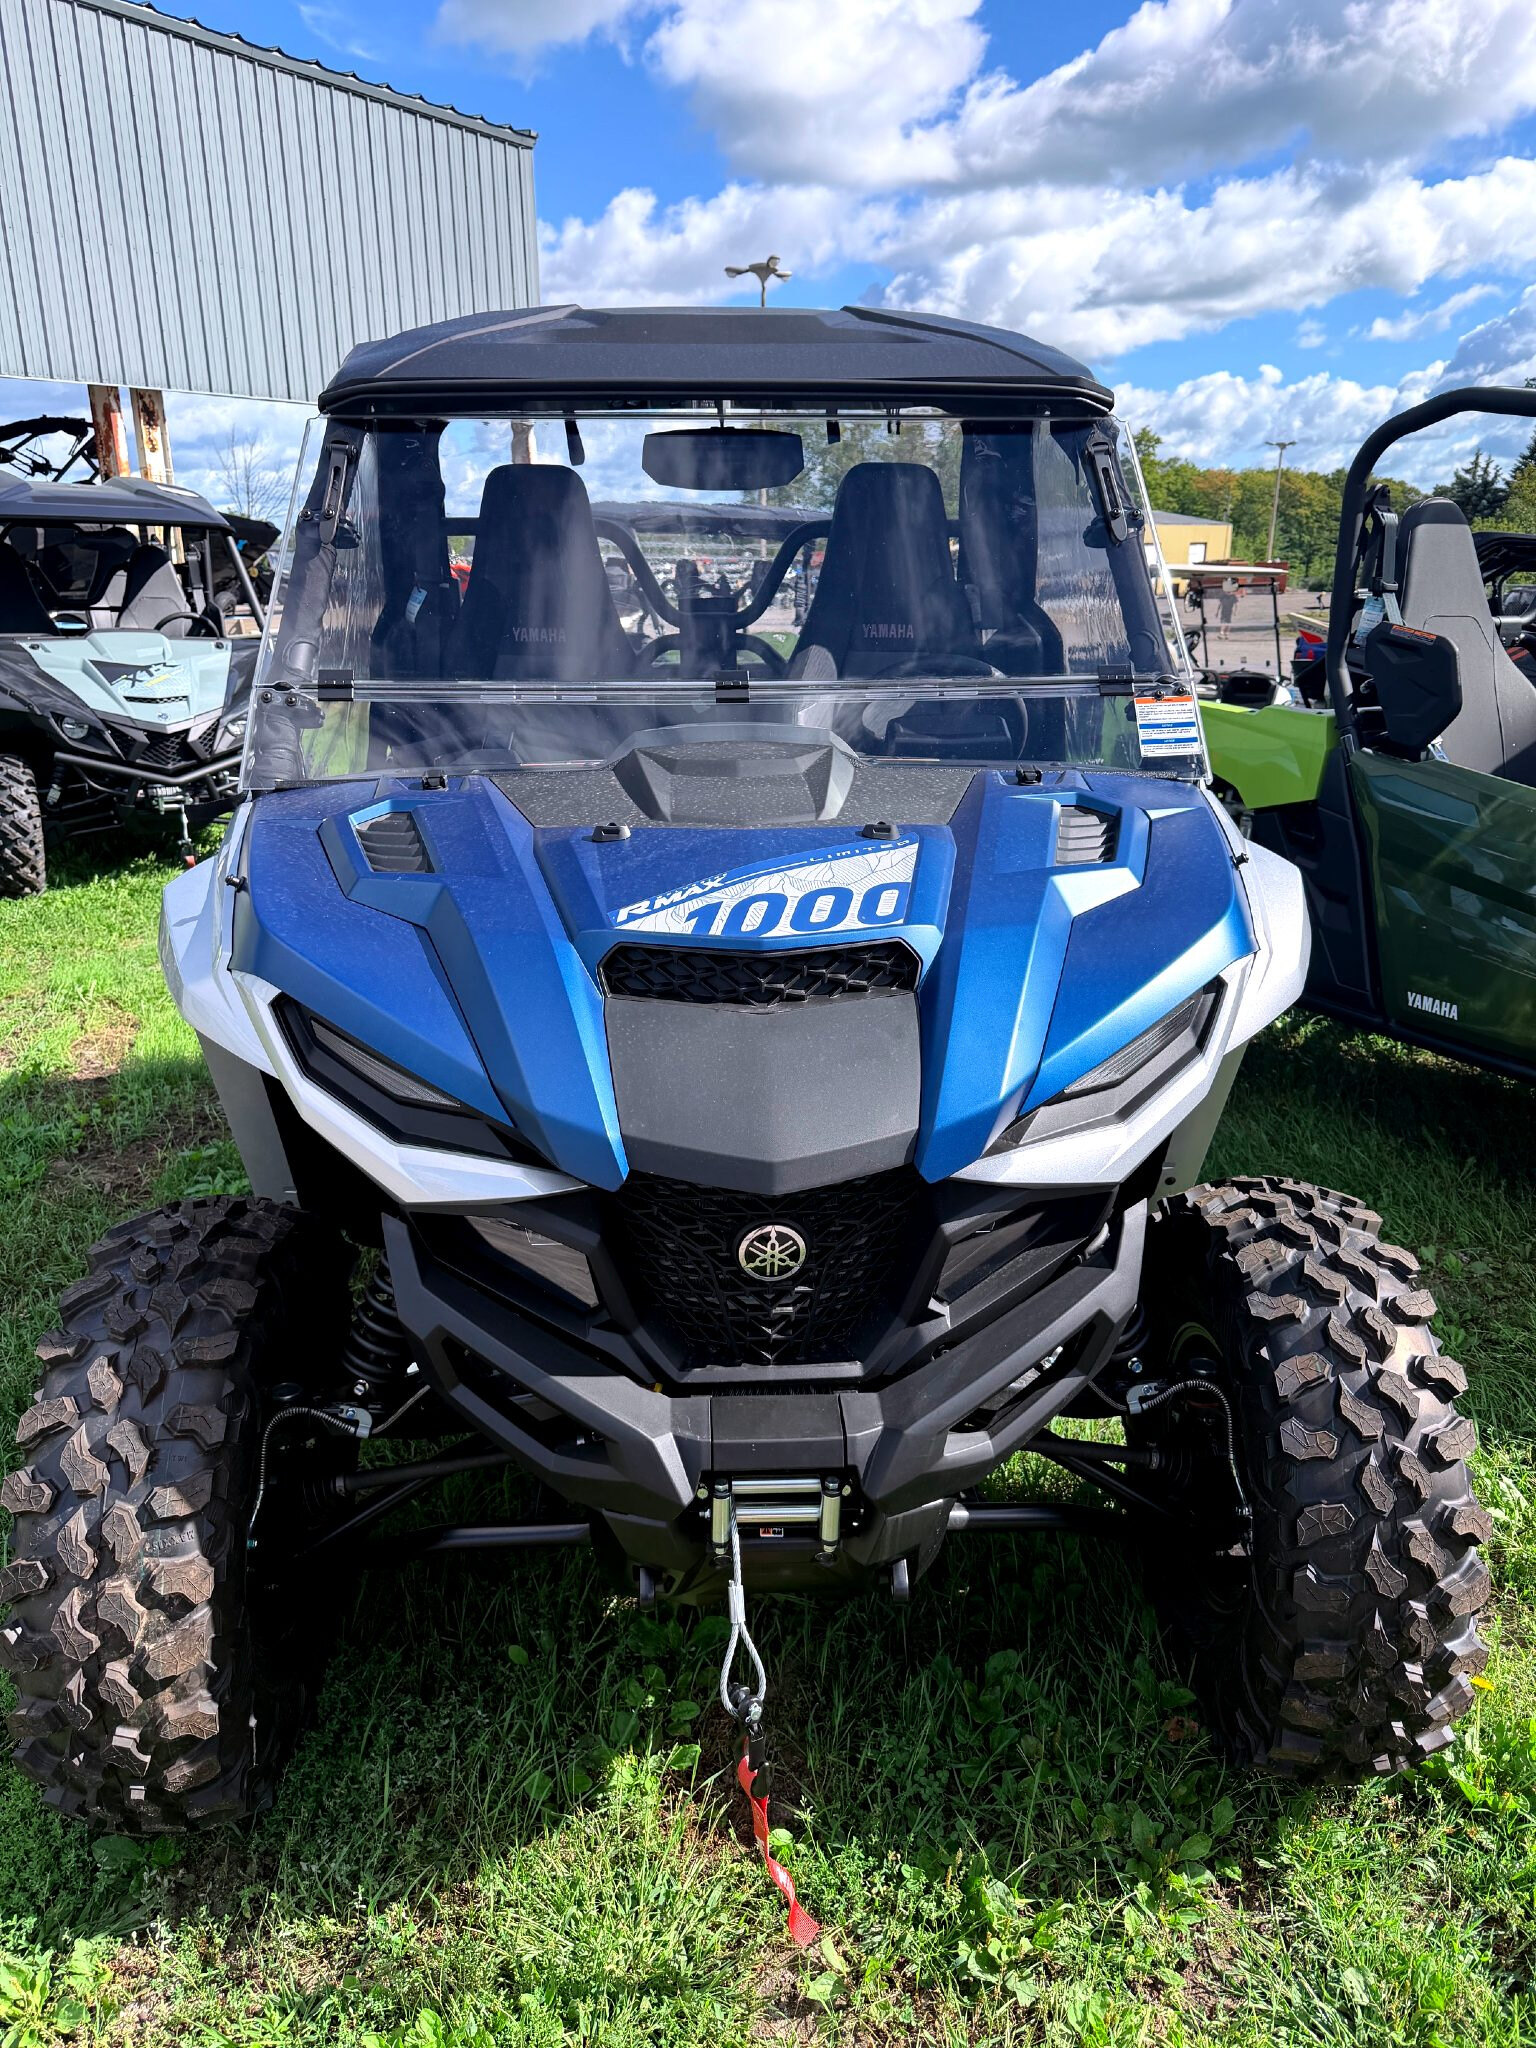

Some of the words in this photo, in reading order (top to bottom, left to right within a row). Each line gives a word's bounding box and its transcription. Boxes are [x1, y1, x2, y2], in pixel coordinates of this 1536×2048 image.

[512, 626, 567, 642] YAMAHA
[862, 624, 914, 639] YAMAHA
[809, 839, 910, 862] LIMITED
[616, 872, 728, 923] RMAX
[683, 881, 911, 937] 1000
[1407, 991, 1459, 1021] YAMAHA
